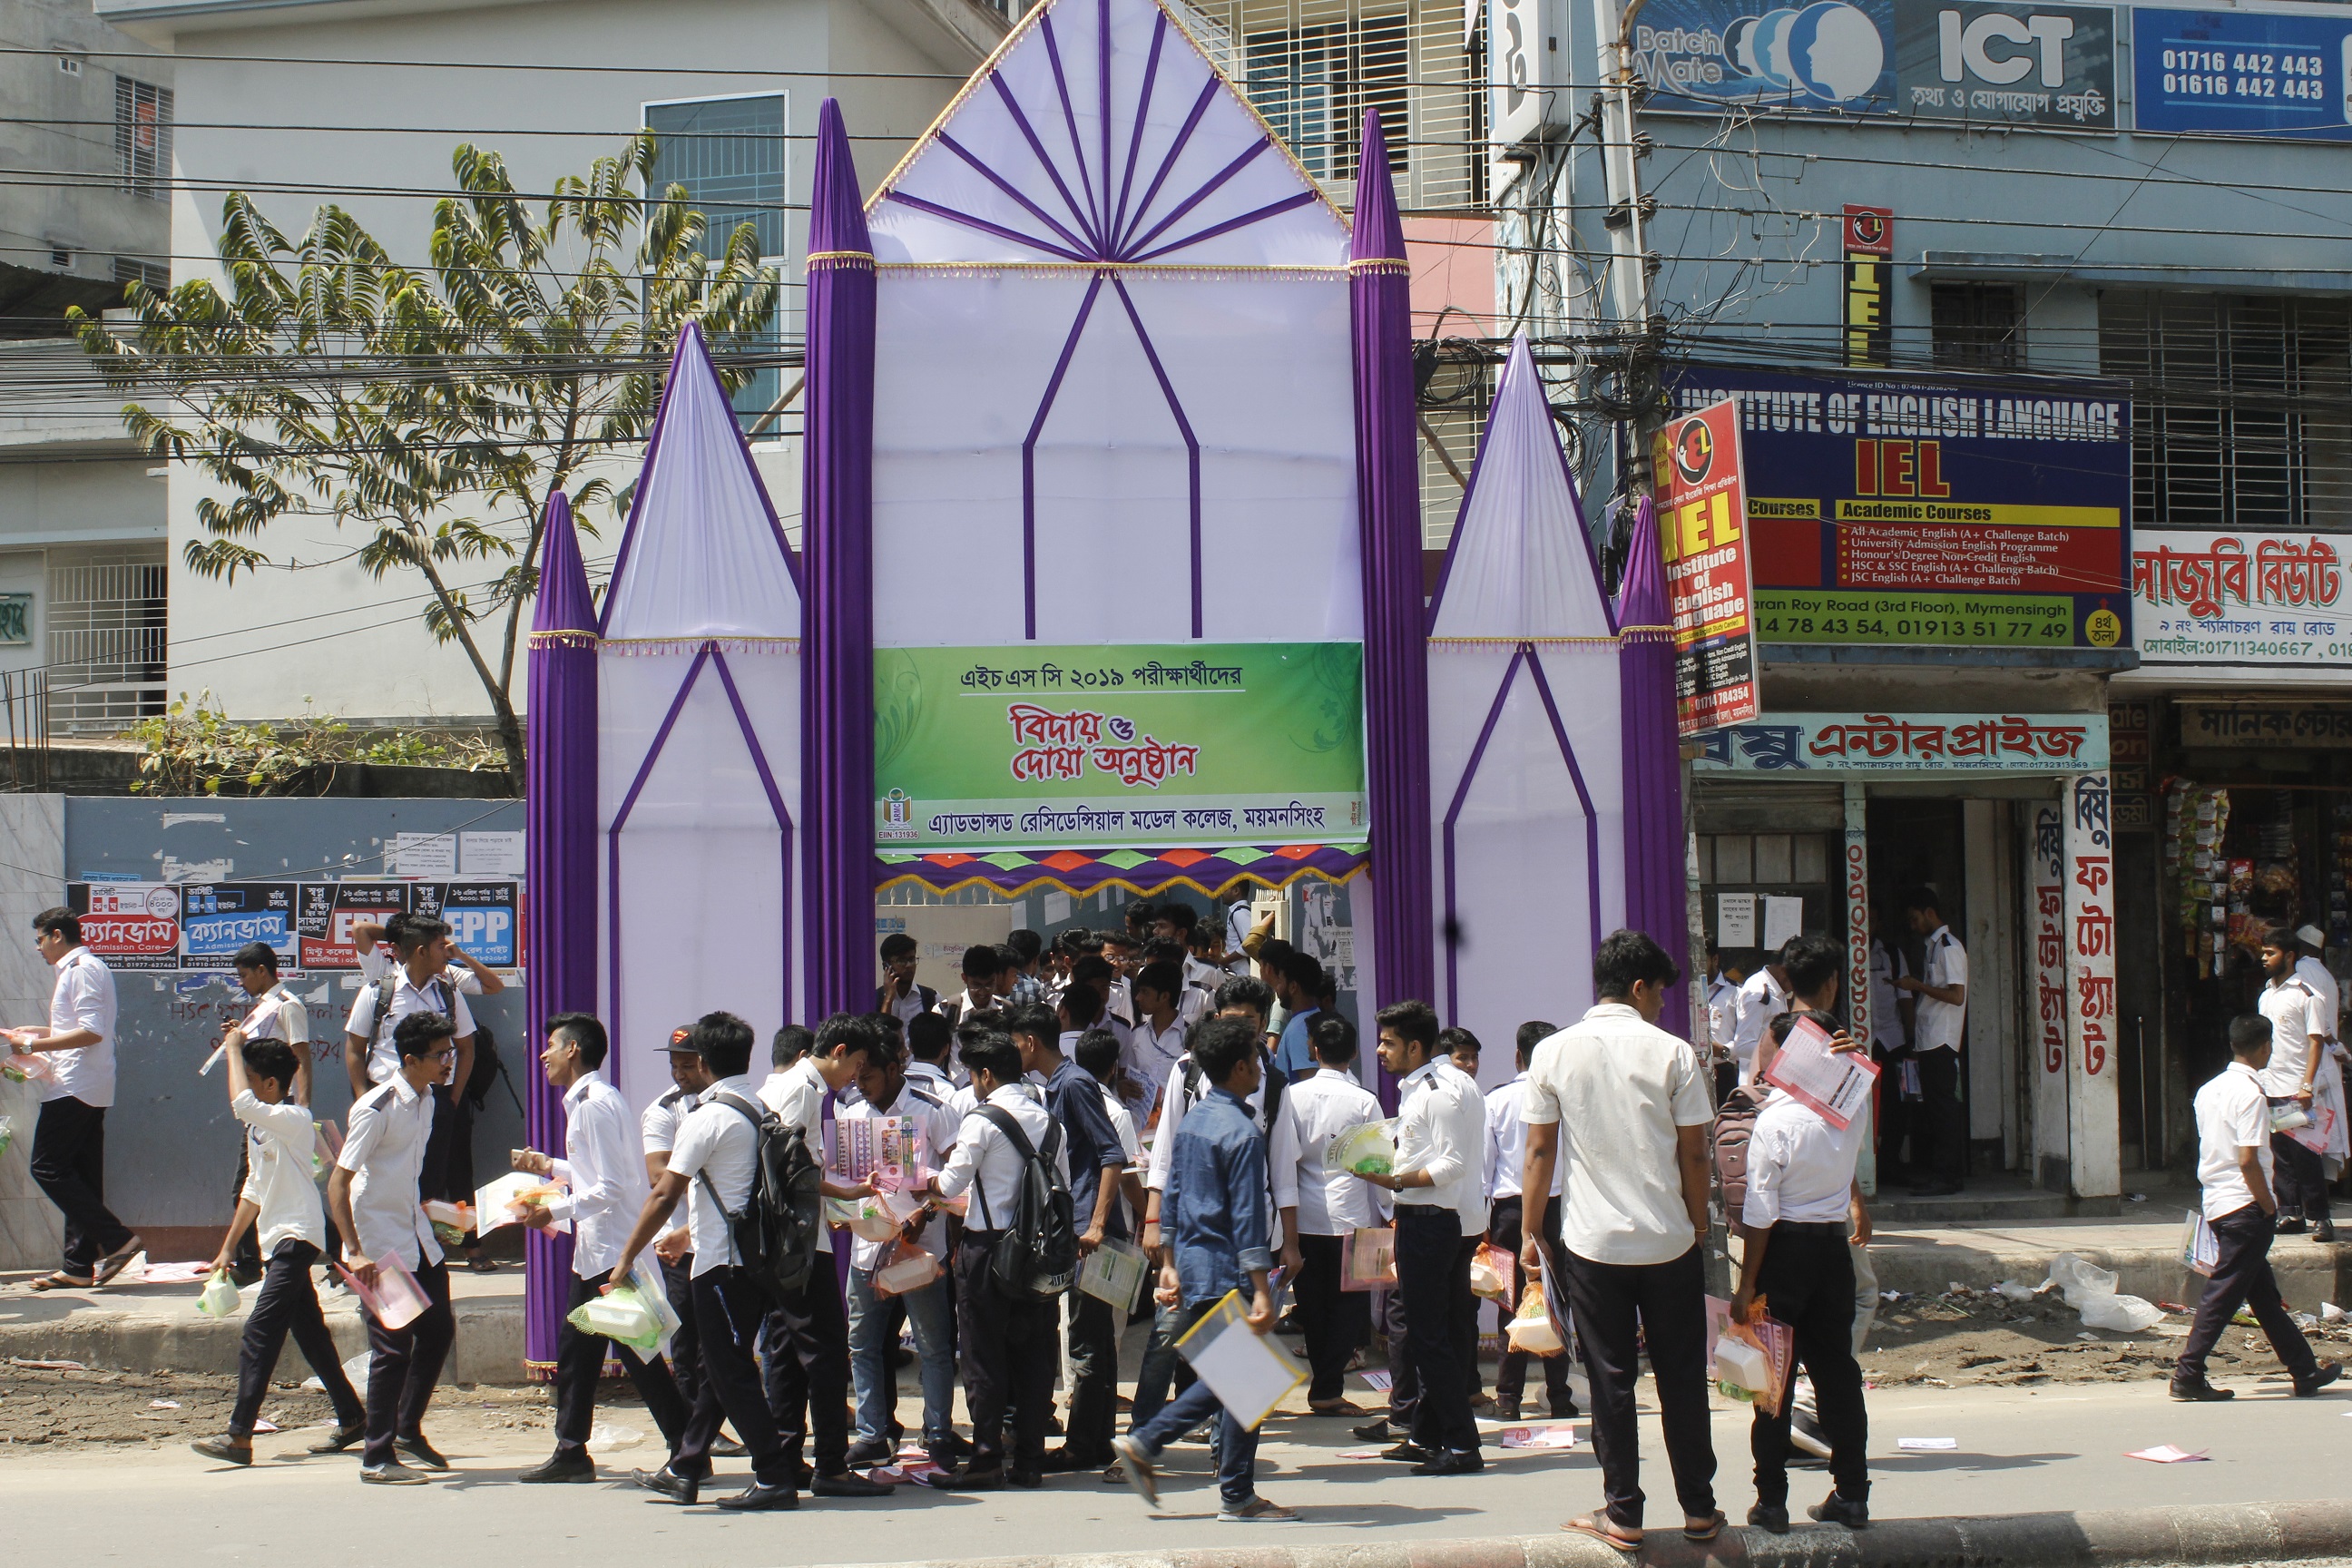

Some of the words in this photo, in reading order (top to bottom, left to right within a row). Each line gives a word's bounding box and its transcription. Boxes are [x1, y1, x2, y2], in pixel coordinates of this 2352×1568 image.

[1636, 25, 1722, 55] Batch
[1939, 10, 2073, 88] ICT
[2162, 50, 2225, 72] 01716
[2233, 54, 2274, 74] 442
[2281, 55, 2322, 76] 443
[2163, 74, 2228, 95] 01616
[2235, 77, 2275, 97] 442
[2282, 79, 2323, 100] 443
[1910, 86, 1945, 107] তথ্য
[1951, 89, 1965, 108] ও
[1970, 90, 2050, 113] যোগাযোগ
[2056, 89, 2105, 122] প্রযুক্তি
[1681, 388, 1822, 432] INTITUTE
[1828, 393, 1860, 434] OF
[1867, 395, 1977, 437] ENGLISH
[1984, 399, 2120, 443] LANGUAGE
[1856, 438, 1950, 497] IEL
[1748, 499, 1815, 515] Courses
[1843, 502, 1922, 518] Academic
[1926, 505, 1991, 521] Courses
[1659, 491, 1740, 564] IEL
[1851, 527, 1865, 535] All
[1868, 527, 1919, 537] Academic
[1922, 528, 1957, 539] English
[1984, 530, 2034, 542] Challenge
[2037, 532, 2069, 542] Batch)
[1851, 538, 1904, 550] University
[1906, 540, 1958, 550] Admission
[1962, 542, 1996, 552] English
[2000, 543, 2058, 553] Programme
[1851, 550, 1938, 562] Honour's/Degree
[1942, 553, 1997, 562] Non-Credit
[2001, 554, 2035, 564] English
[1667, 547, 1737, 582] Institute
[1851, 562, 1874, 570] HSC
[1877, 562, 1886, 571] &
[1889, 563, 1909, 571] SSC
[1912, 563, 1946, 573] English
[1975, 564, 2024, 575] Challenge
[2027, 565, 2059, 575] Batch)
[2256, 535, 2339, 604] বিউটি
[1693, 570, 1710, 590] of
[1851, 573, 1868, 583] JSC
[1872, 573, 1907, 584] English
[1935, 574, 1985, 585] Challenge
[1988, 576, 2020, 585] Batch)
[1674, 581, 1733, 613] English
[1791, 599, 1821, 612] Roy
[1827, 600, 1868, 612] Road
[1875, 600, 1906, 613] (3rd
[1911, 602, 1959, 615] Floor),
[1965, 603, 2066, 618] Mymensingh
[1673, 597, 1744, 631] anguage
[2095, 614, 2112, 629] ৪র্থ
[1788, 618, 1814, 632] 78
[1821, 619, 1848, 633] 43
[1857, 620, 1889, 636] 54,
[1897, 620, 1965, 636] 01913
[1973, 622, 1995, 636] 51
[2007, 622, 2032, 637] 77
[2041, 623, 2066, 639] 49
[2092, 630, 2114, 642] তলা
[2160, 621, 2170, 631] ৯
[2175, 621, 2191, 632] নং
[2197, 621, 2261, 634] শ্যামাচরণ
[2270, 622, 2296, 635] রায়
[2304, 622, 2336, 636] রোড
[960, 664, 1004, 691] এইচ
[1005, 667, 1038, 689] এস
[1041, 663, 1063, 687] সি
[1071, 669, 1123, 689] ২০১৯
[1132, 661, 1242, 687] পরীক্ষার্থীদের
[1695, 693, 1717, 710] 01714
[1719, 686, 1749, 705] 784354
[1009, 704, 1103, 745] বিদায়
[1109, 717, 1134, 740] ও
[2198, 702, 2292, 736] মানিক
[1808, 714, 2087, 760] এন্টারপ্রাইজ
[1012, 743, 1085, 781] দোয়া
[1094, 736, 1199, 789] অনুষ্ঠান
[1021, 805, 1125, 833] রেসিডেন্সিয়াল
[1130, 808, 1178, 830] মডেল
[1181, 808, 1238, 832] কলেজ,
[1242, 800, 1325, 829] ময়মনসিংহ
[189, 916, 282, 942] ক্যানভাস
[444, 911, 509, 943] EPP
